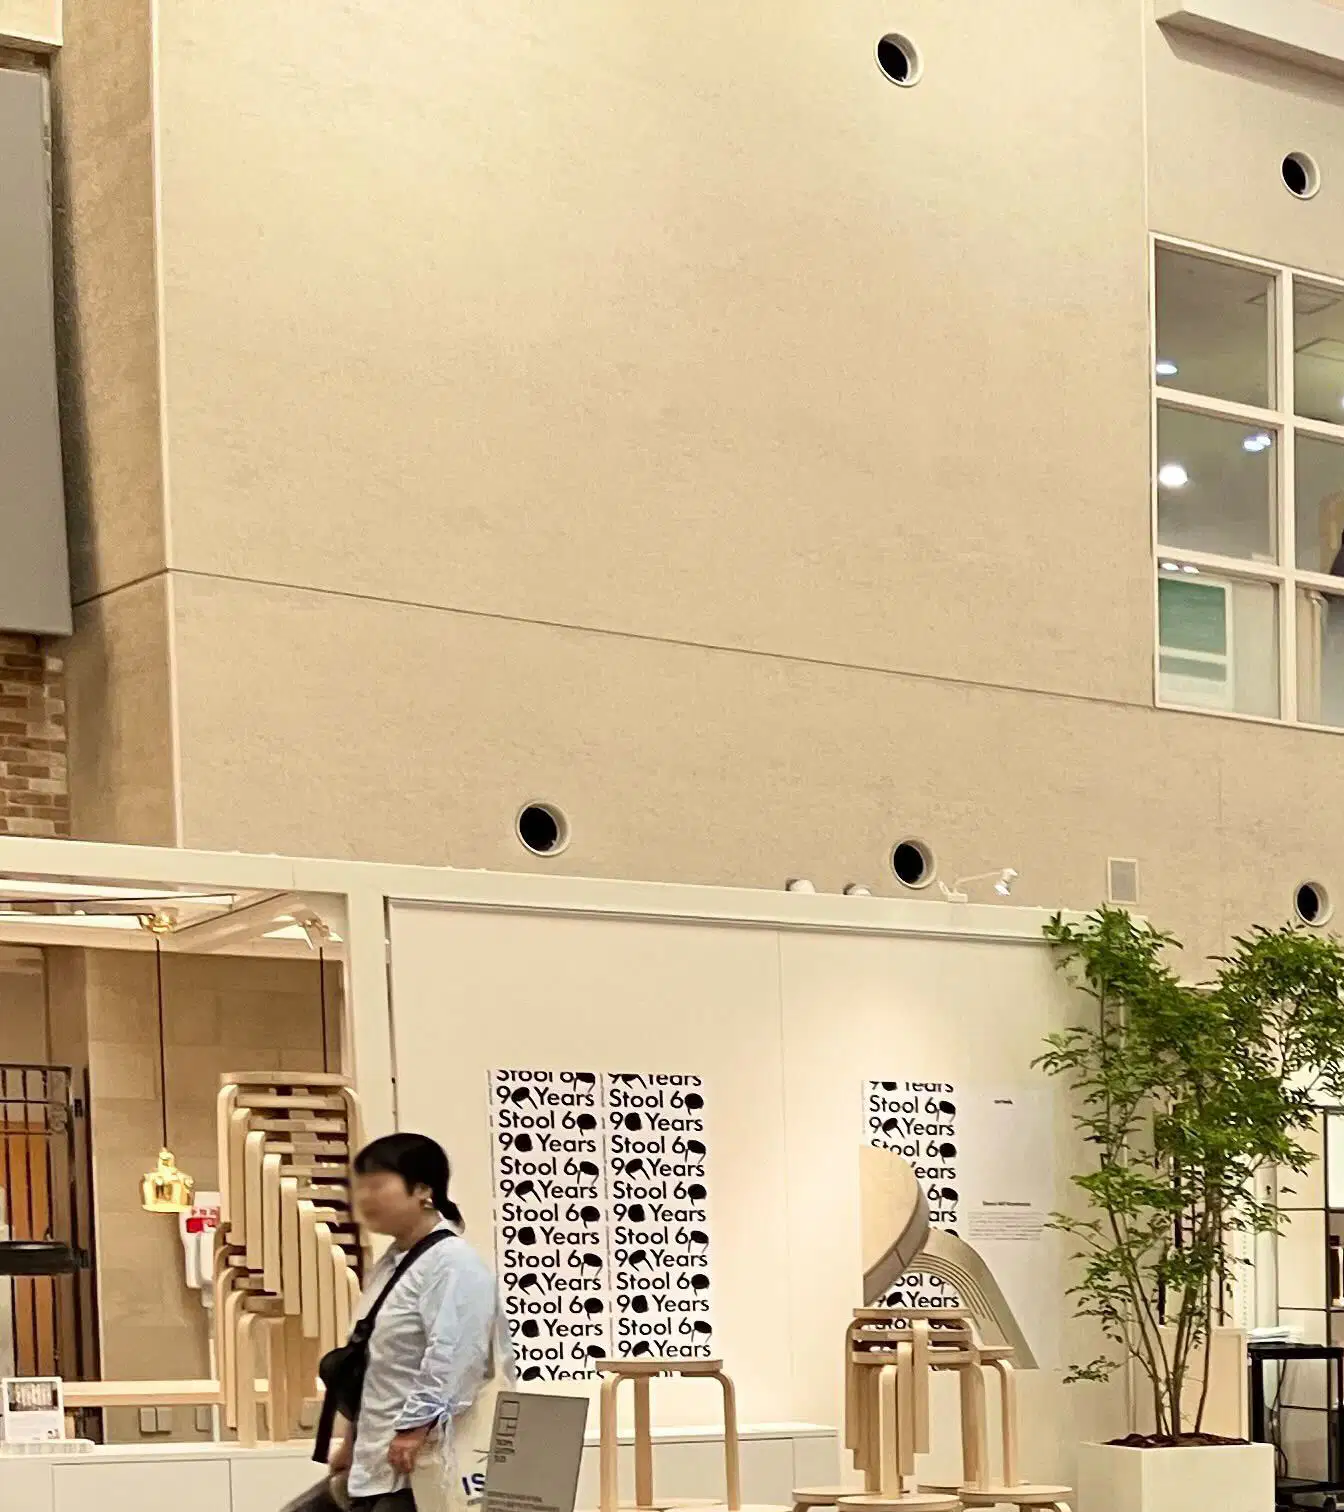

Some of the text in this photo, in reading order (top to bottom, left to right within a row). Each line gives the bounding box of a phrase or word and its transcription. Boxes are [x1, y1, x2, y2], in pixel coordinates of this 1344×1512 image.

[534, 1087, 594, 1106] Years
[609, 1089, 663, 1108] Stool
[869, 1095, 919, 1113] Stool
[500, 1109, 554, 1128] Stool
[645, 1113, 703, 1131] Years
[902, 1117, 955, 1136] Years
[536, 1133, 596, 1152] Years
[611, 1135, 665, 1153] Stool
[501, 1156, 556, 1175] Stool
[647, 1158, 705, 1177] Years
[911, 1161, 956, 1179] ears
[538, 1180, 598, 1198] Years
[613, 1181, 666, 1199] Stool
[502, 1203, 558, 1222] Stool
[648, 1204, 705, 1221] Years
[929, 1211, 957, 1222] ars
[540, 1226, 599, 1245] Years
[615, 1226, 668, 1245] Stool
[504, 1249, 560, 1268] Stool
[650, 1249, 708, 1267] Years
[542, 1273, 601, 1291] Years
[616, 1272, 670, 1291] Stool
[506, 1296, 561, 1314] Stool
[652, 1294, 709, 1312] Years
[906, 1291, 959, 1308] Years
[544, 1319, 603, 1337] Years
[618, 1318, 671, 1336] Stool
[654, 1340, 711, 1357] Years
